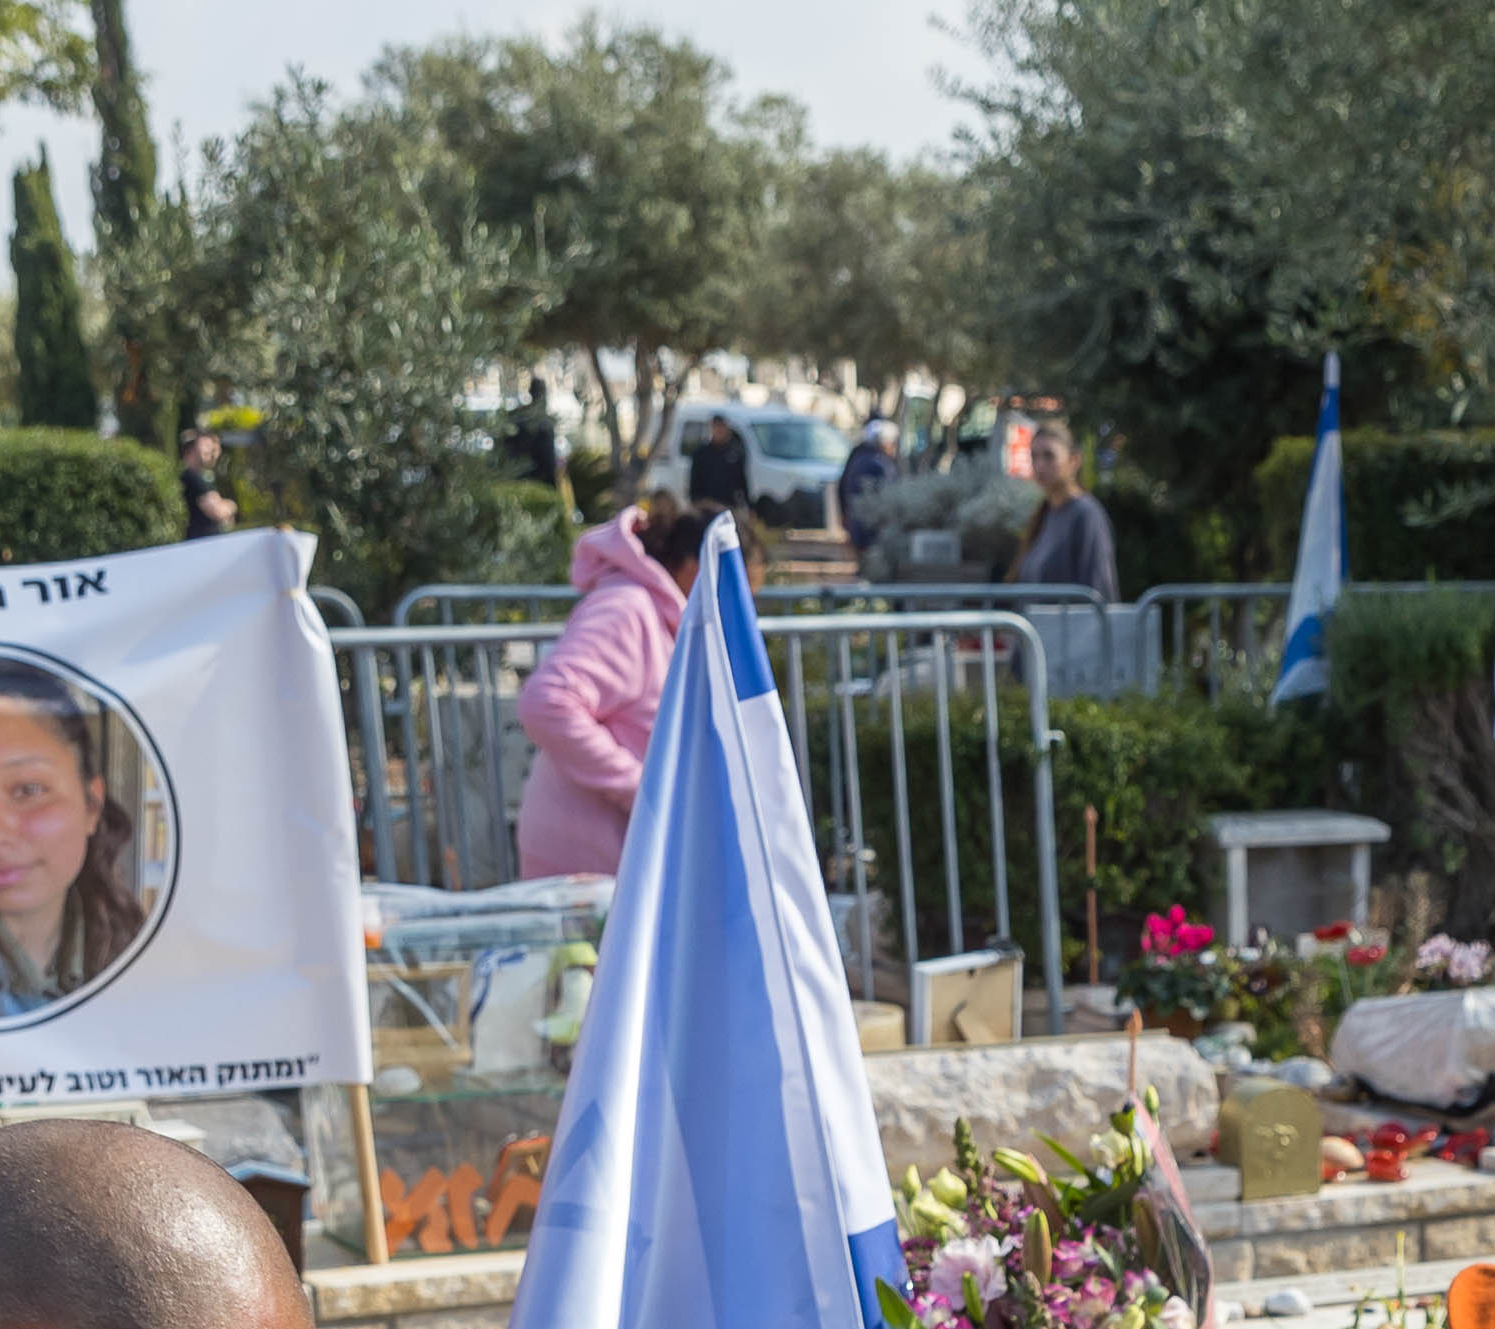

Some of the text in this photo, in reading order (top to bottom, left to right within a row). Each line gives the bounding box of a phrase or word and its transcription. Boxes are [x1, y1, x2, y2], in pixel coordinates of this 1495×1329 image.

[21, 568, 108, 604] אור
[66, 1067, 129, 1092] וטוב
[137, 1063, 207, 1086] האור
